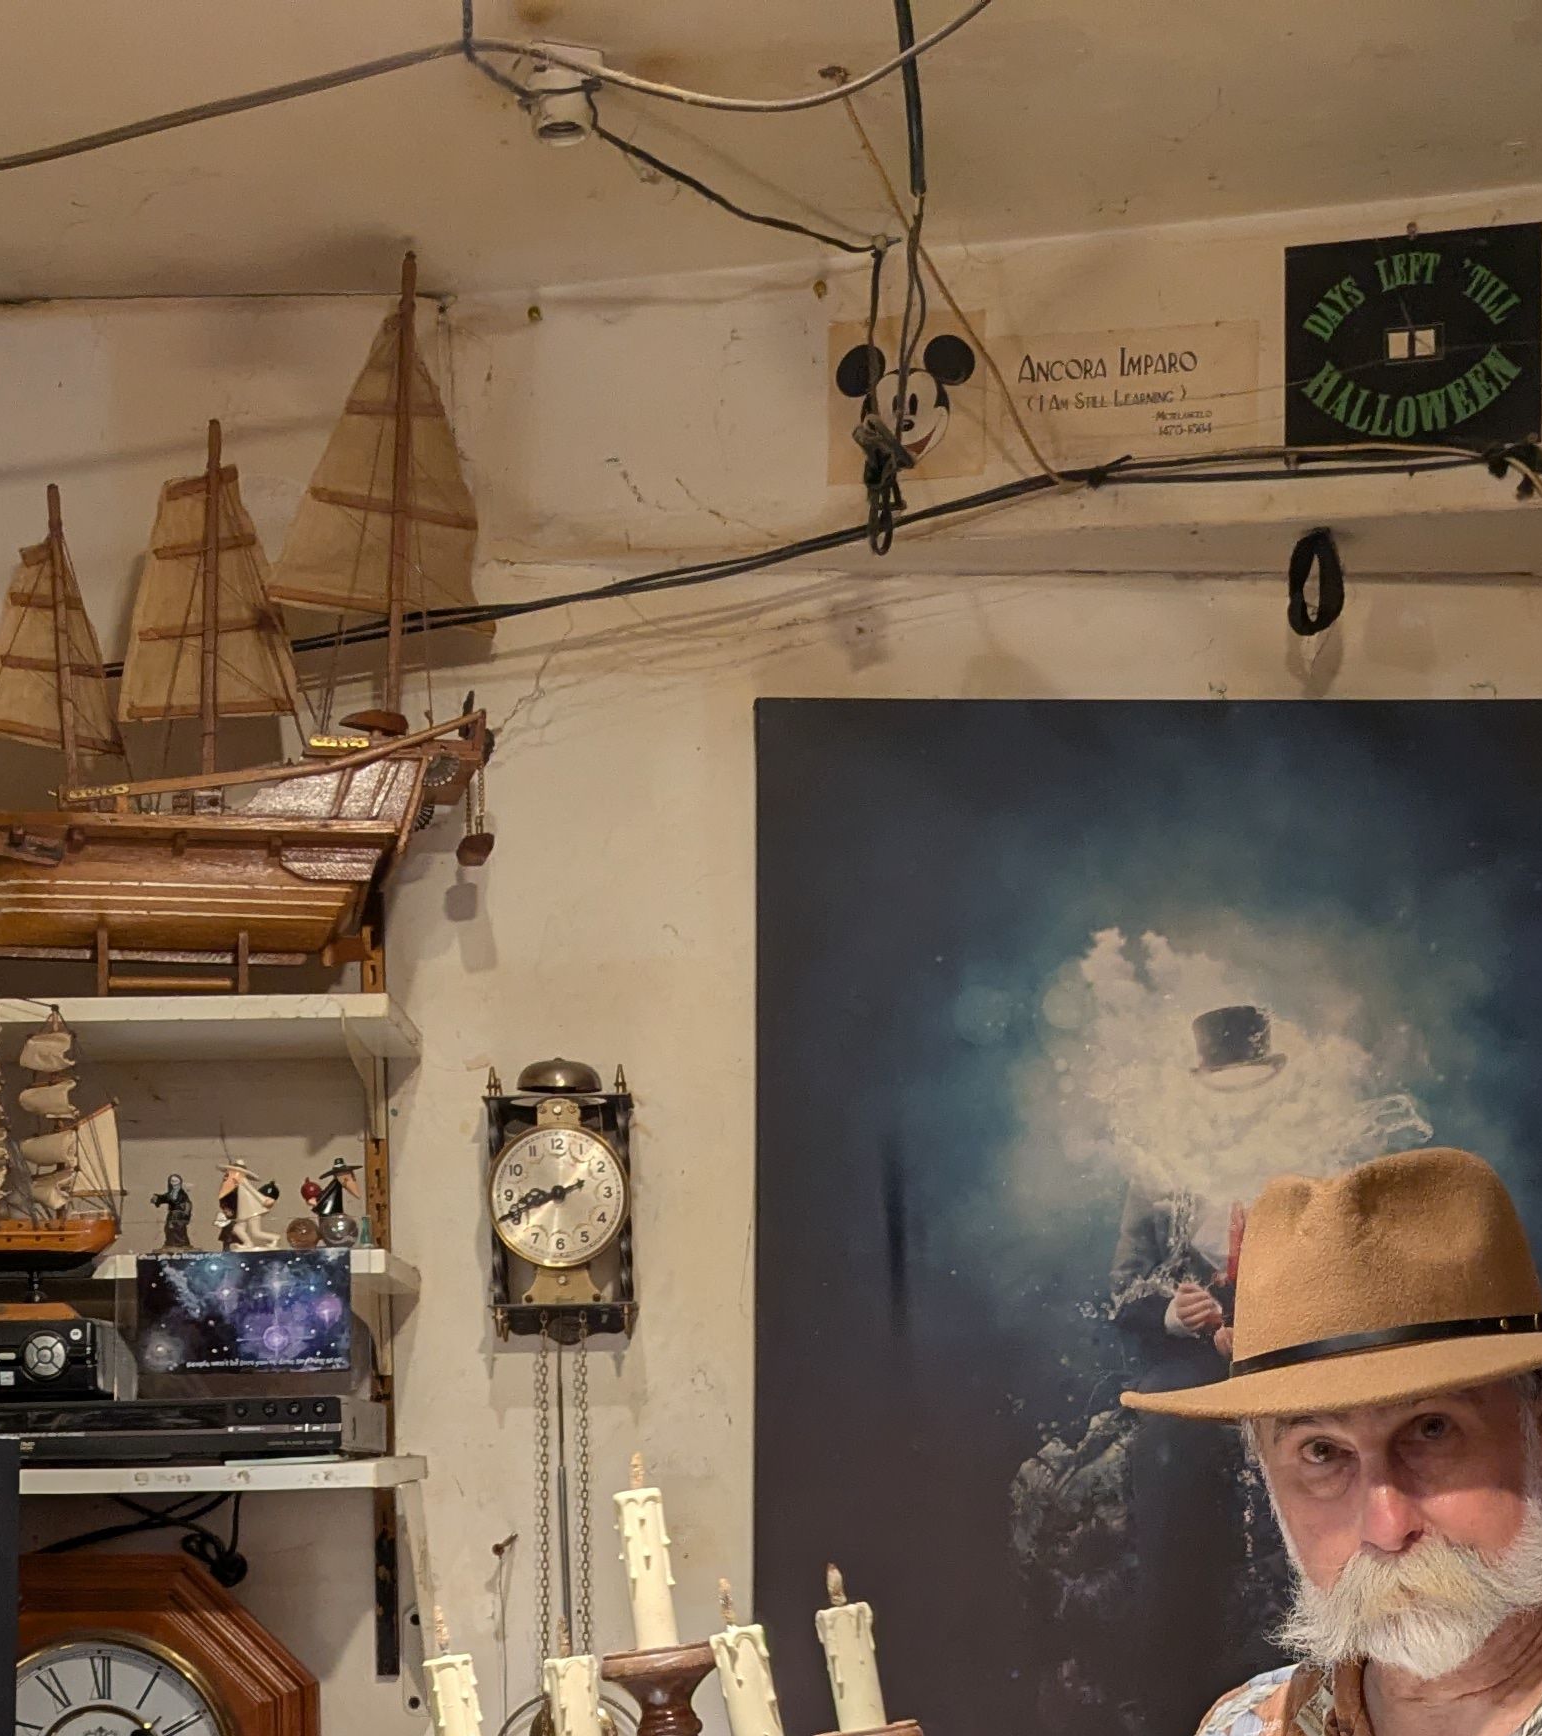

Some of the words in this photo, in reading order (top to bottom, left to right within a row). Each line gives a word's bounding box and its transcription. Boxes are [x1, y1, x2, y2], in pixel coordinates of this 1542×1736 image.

[1302, 275, 1366, 342] DAYS
[1375, 252, 1441, 293] LEFT
[1302, 344, 1522, 438] HALLOWEEN
[550, 1138, 565, 1150] 12
[528, 1145, 537, 1157] 11
[508, 1163, 523, 1177] 10
[597, 1161, 606, 1173] 2
[504, 1189, 514, 1202] 9
[603, 1186, 613, 1199] 3
[597, 1211, 607, 1224] 4
[531, 1232, 540, 1244] 7
[556, 1237, 565, 1250] 6
[580, 1231, 590, 1243] 5
